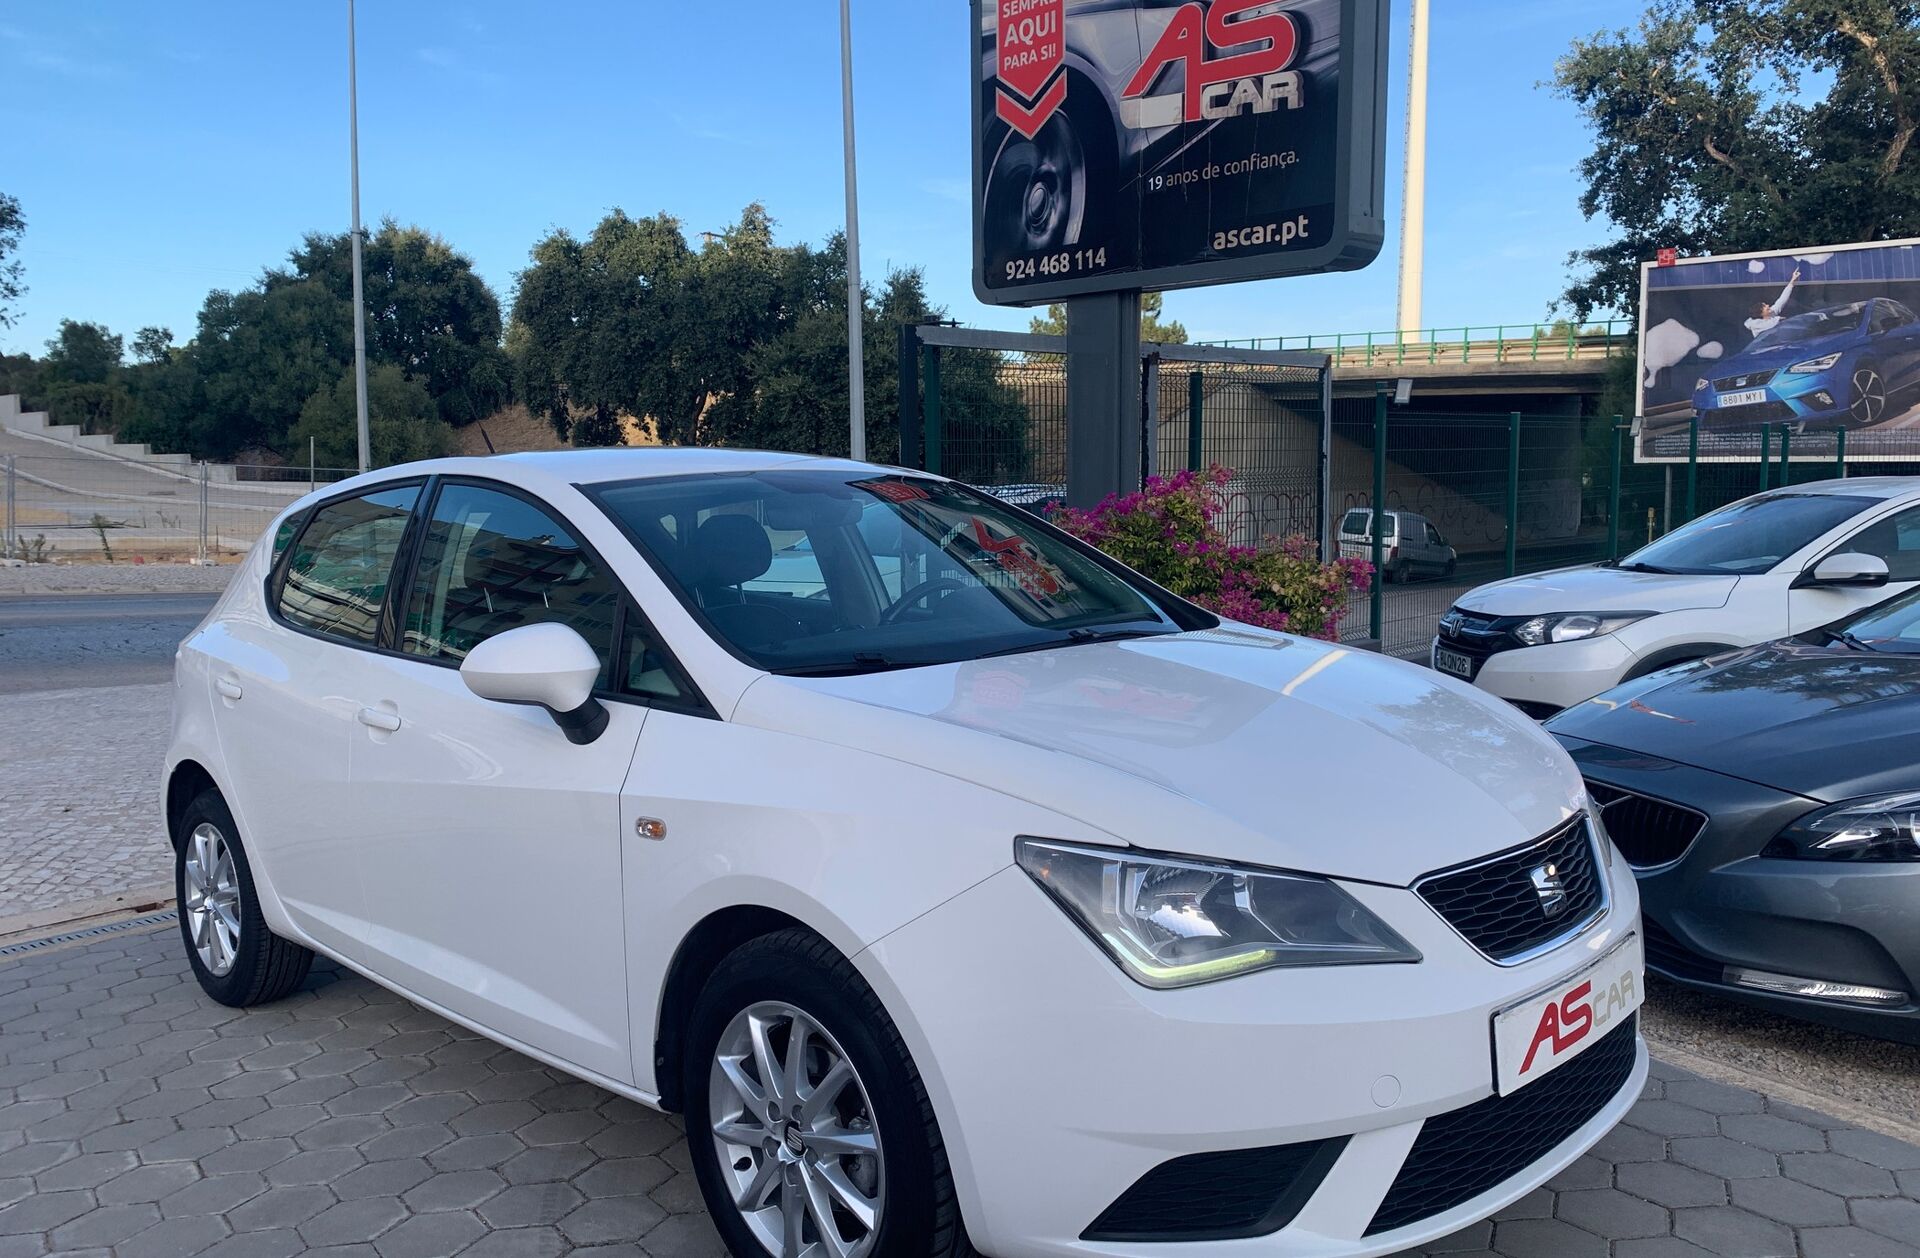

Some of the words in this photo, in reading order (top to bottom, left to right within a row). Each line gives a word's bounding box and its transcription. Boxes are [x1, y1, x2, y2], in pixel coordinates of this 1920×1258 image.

[1003, 0, 1057, 18] SEMP
[1004, 10, 1056, 48] AQUI
[1004, 49, 1038, 71] PARA
[1041, 43, 1056, 60] SI!
[1120, 0, 1296, 122] AS
[1202, 70, 1304, 119] CAR
[1148, 176, 1163, 191] 19
[1166, 169, 1199, 187] anos
[1202, 162, 1220, 180] de
[1223, 150, 1300, 174] confiança.
[1213, 214, 1309, 250] ascar.pt
[1006, 258, 1036, 280] 924
[1039, 254, 1070, 275] 468
[1075, 247, 1107, 270] 114
